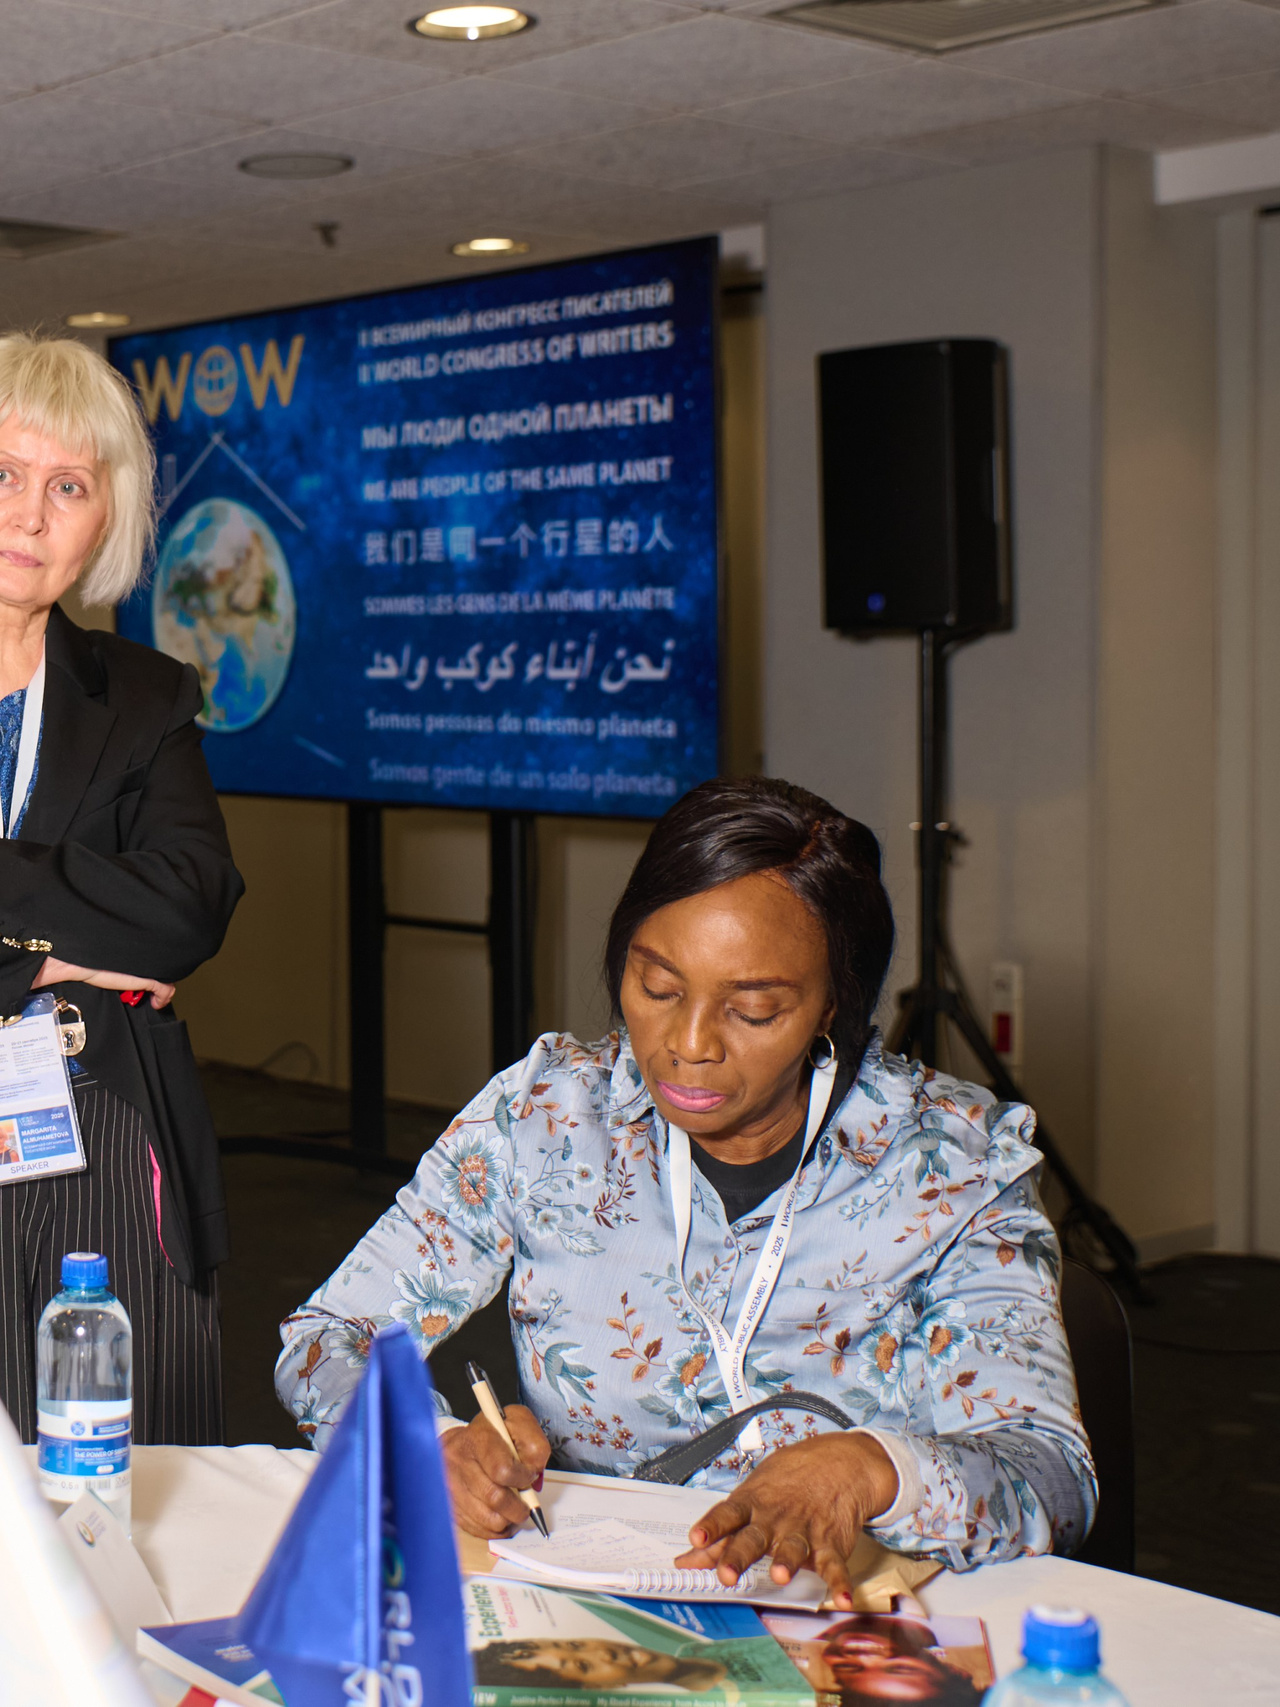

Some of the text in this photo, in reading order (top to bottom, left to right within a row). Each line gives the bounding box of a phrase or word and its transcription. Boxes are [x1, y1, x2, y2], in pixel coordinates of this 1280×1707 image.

[372, 309, 471, 347] ВСЕМИРНЫЙ
[475, 300, 560, 333] КОНГРЕСС
[561, 278, 674, 320] ПИСАТЕЛЕЙ
[374, 353, 440, 382] WORLD
[441, 338, 544, 375] CONGRESS
[547, 333, 576, 362] OF
[578, 320, 675, 358] WRITERS
[132, 334, 305, 426] WOW
[362, 393, 673, 449] МЫ ЛЮДИ ОДНОЙ ПЛАНЕТЫ
[390, 477, 418, 500] ARE
[421, 472, 481, 498] PEOPLE
[484, 469, 506, 493] OF
[511, 467, 543, 491] THE
[546, 462, 596, 489] SAME
[598, 455, 673, 485] PLANET
[365, 595, 425, 616] SOMMES
[365, 645, 428, 690] واحد
[435, 642, 518, 692] كوكب
[599, 639, 675, 693] نحن
[366, 708, 677, 742] Somos pessoas do mesmo planeta
[593, 766, 677, 799] planeta
[21, 1125, 57, 1137] MARGARITA
[10, 1160, 49, 1175] SPEAKER
[782, 1191, 796, 1223] WORLD
[732, 1235, 784, 1393] WORLD PUBLIC ASSEMBLY 2025
[470, 1583, 505, 1637] Experience
